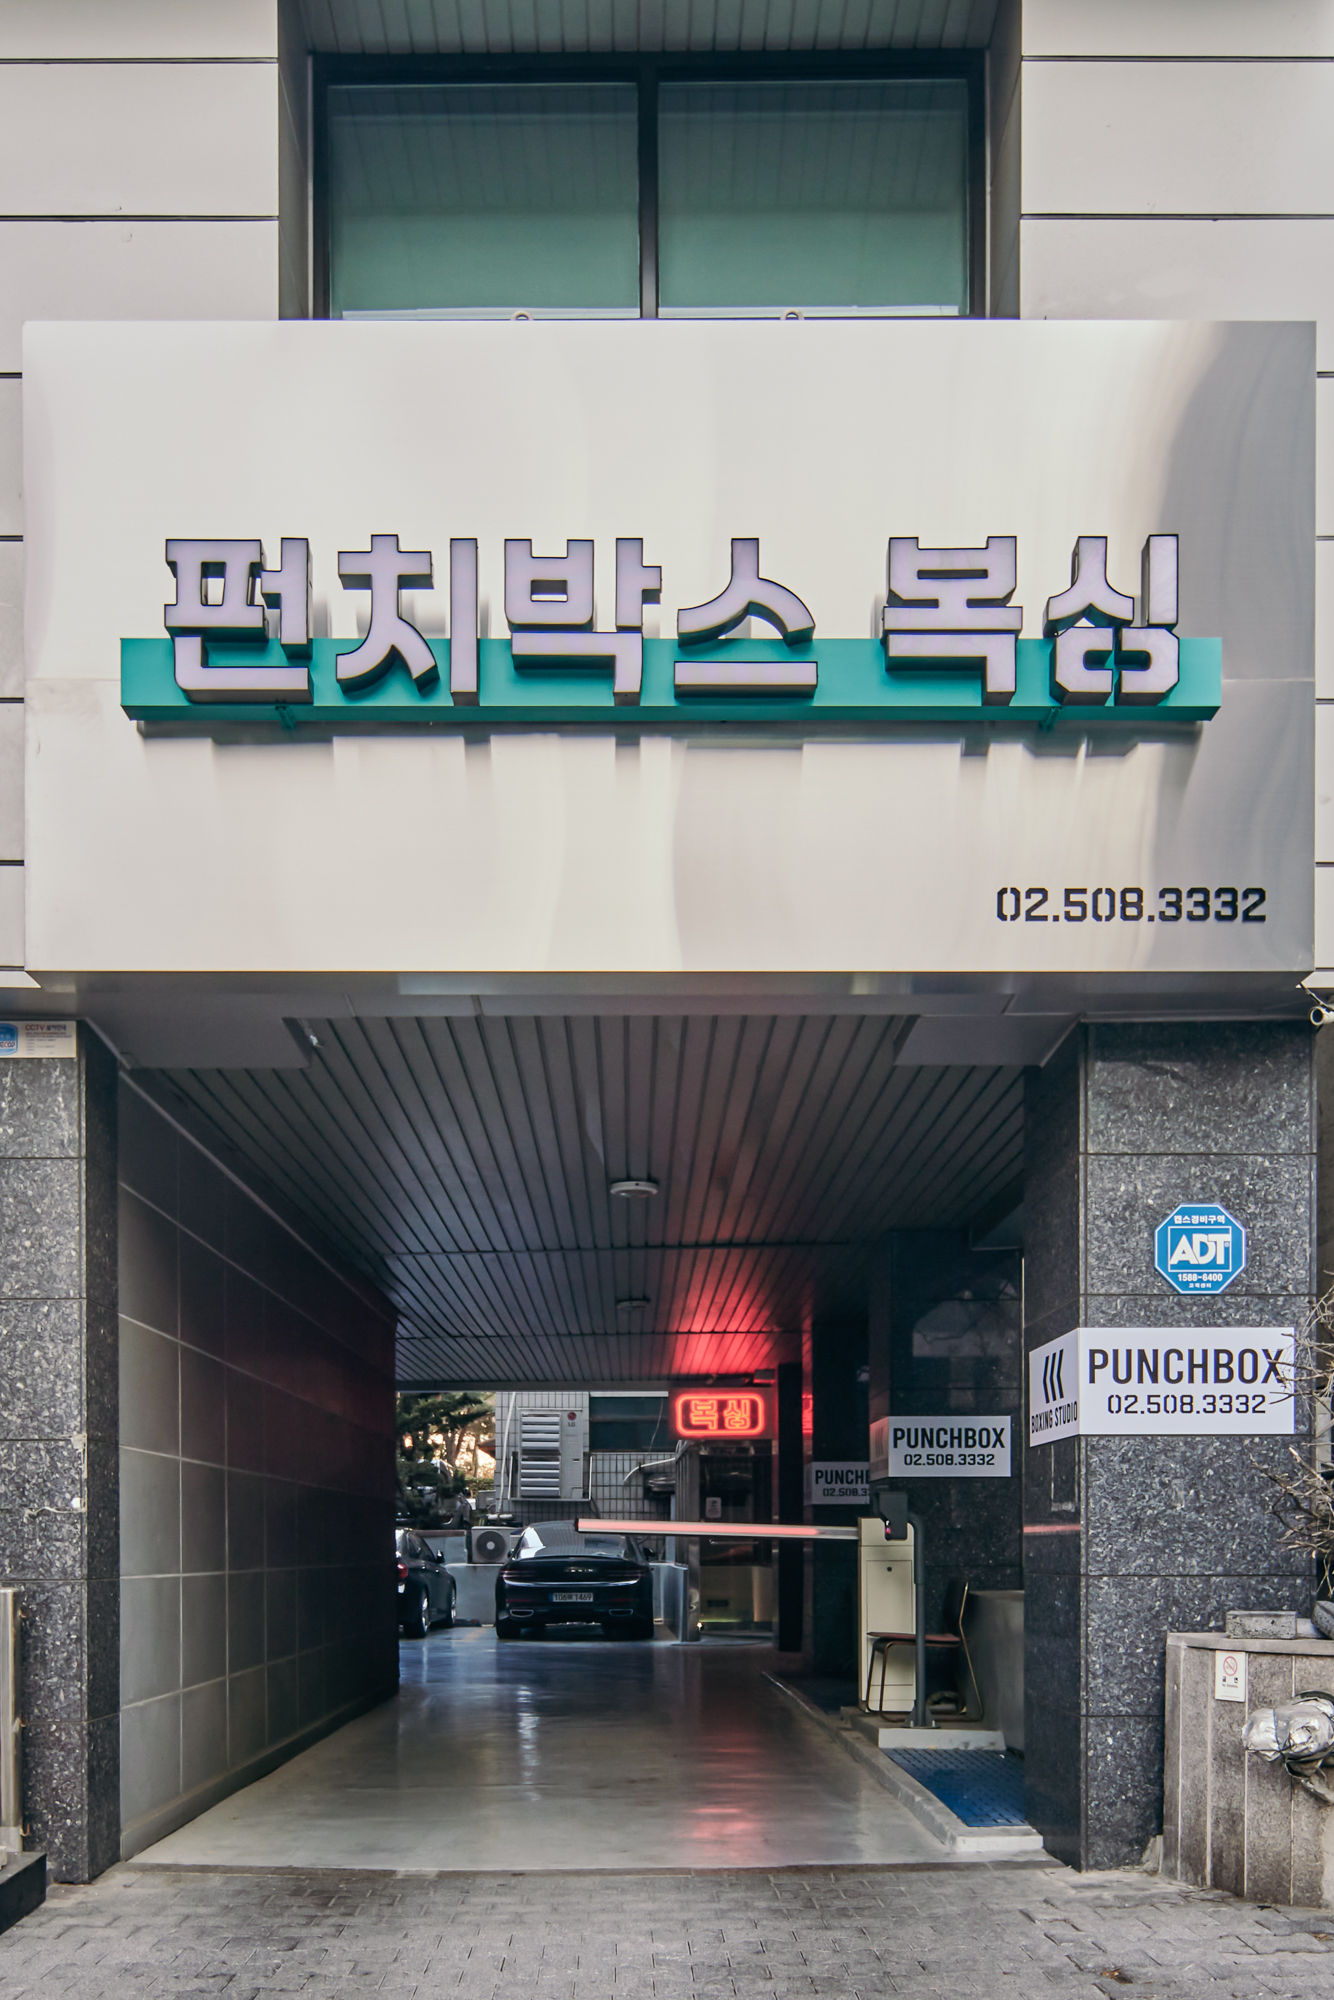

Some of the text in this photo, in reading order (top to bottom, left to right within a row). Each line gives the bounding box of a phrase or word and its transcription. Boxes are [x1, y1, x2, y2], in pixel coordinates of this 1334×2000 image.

[164, 533, 1181, 706] 펀치박스 복싱
[996, 886, 1267, 923] 02.508.3332
[1169, 1233, 1231, 1265] ADT
[1177, 1273, 1223, 1282] 1588-6400
[1088, 1348, 1285, 1384] PUNCHBOX
[690, 1399, 751, 1430] 복싱
[1031, 1401, 1078, 1434] BOXING STUDIO
[1107, 1394, 1266, 1414] 02.508.3332
[893, 1427, 1005, 1448] PUNCHBOX
[904, 1454, 995, 1466] 02.508.3332
